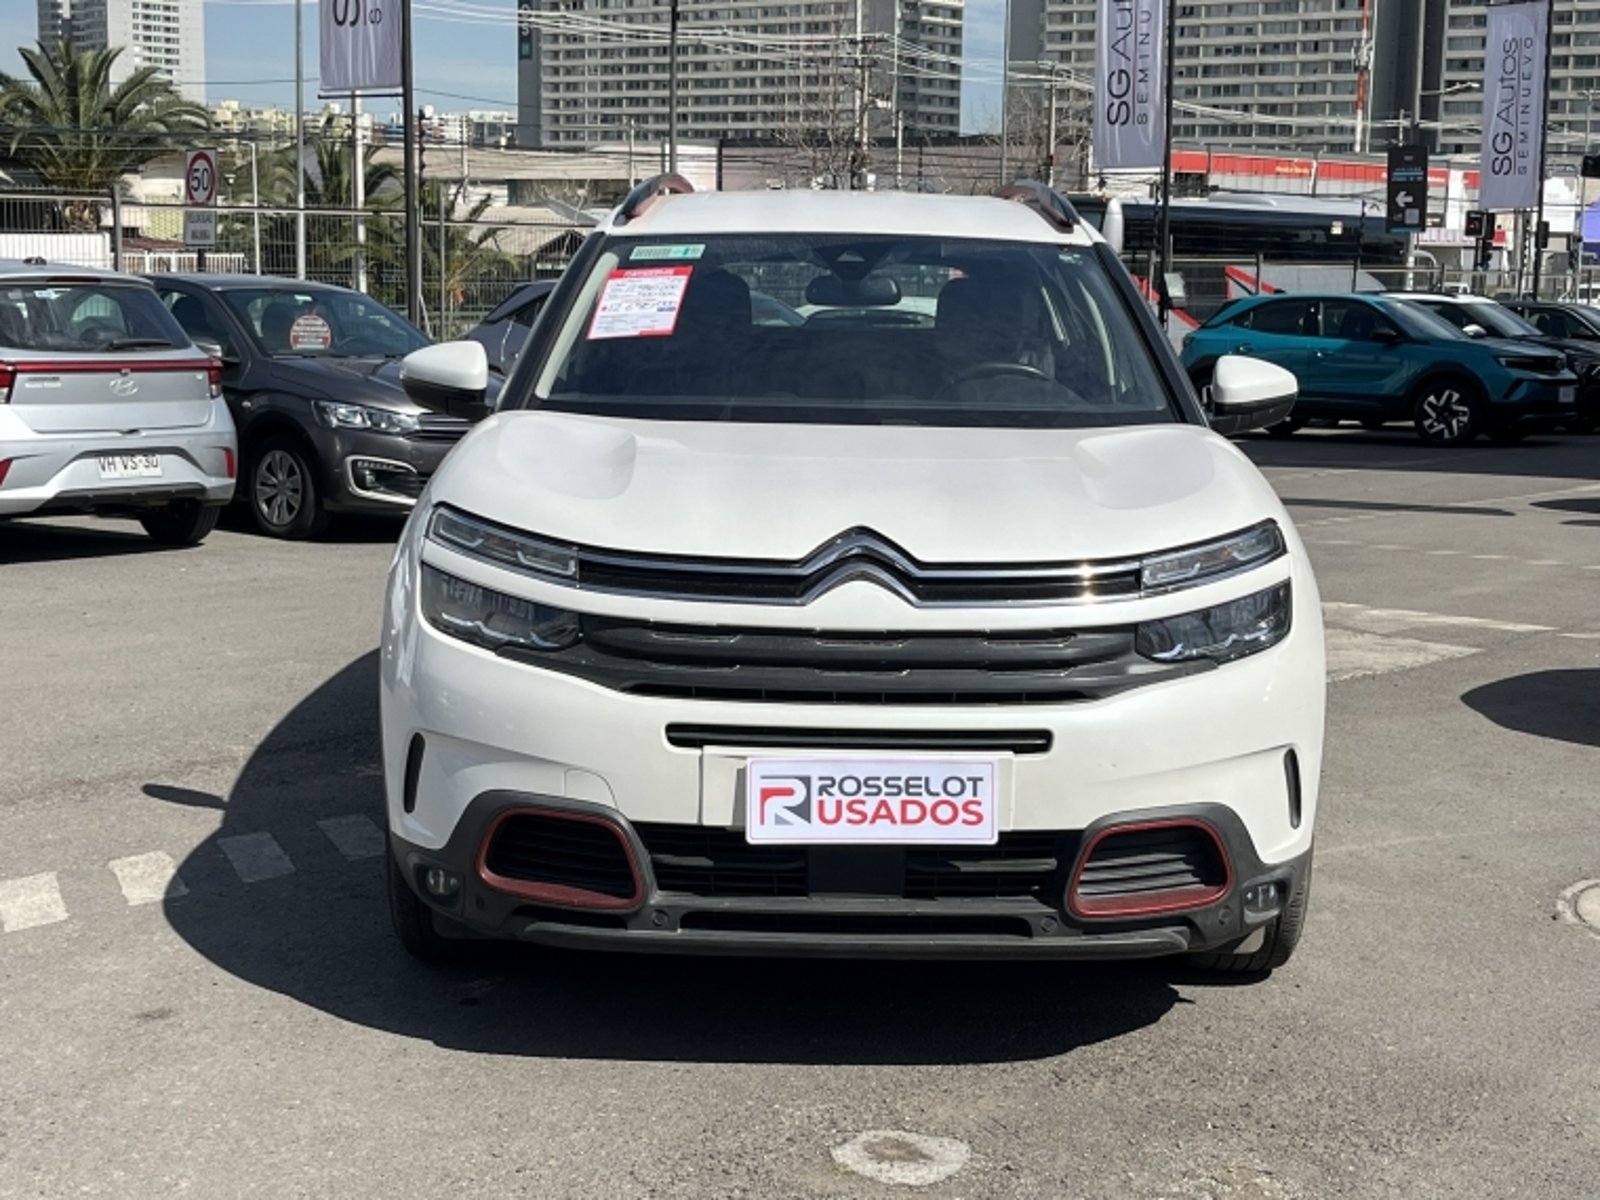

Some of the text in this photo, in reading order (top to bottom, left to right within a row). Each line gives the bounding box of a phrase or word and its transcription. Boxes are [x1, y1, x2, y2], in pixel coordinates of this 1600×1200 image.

[1137, 10, 1152, 125] SEMINU
[1107, 69, 1131, 126] SG
[1518, 37, 1534, 175] SEMINUEVO
[1492, 131, 1513, 175] SG
[191, 167, 209, 192] 50
[817, 775, 984, 798] ROSSELOT
[817, 799, 985, 826] USADOS
